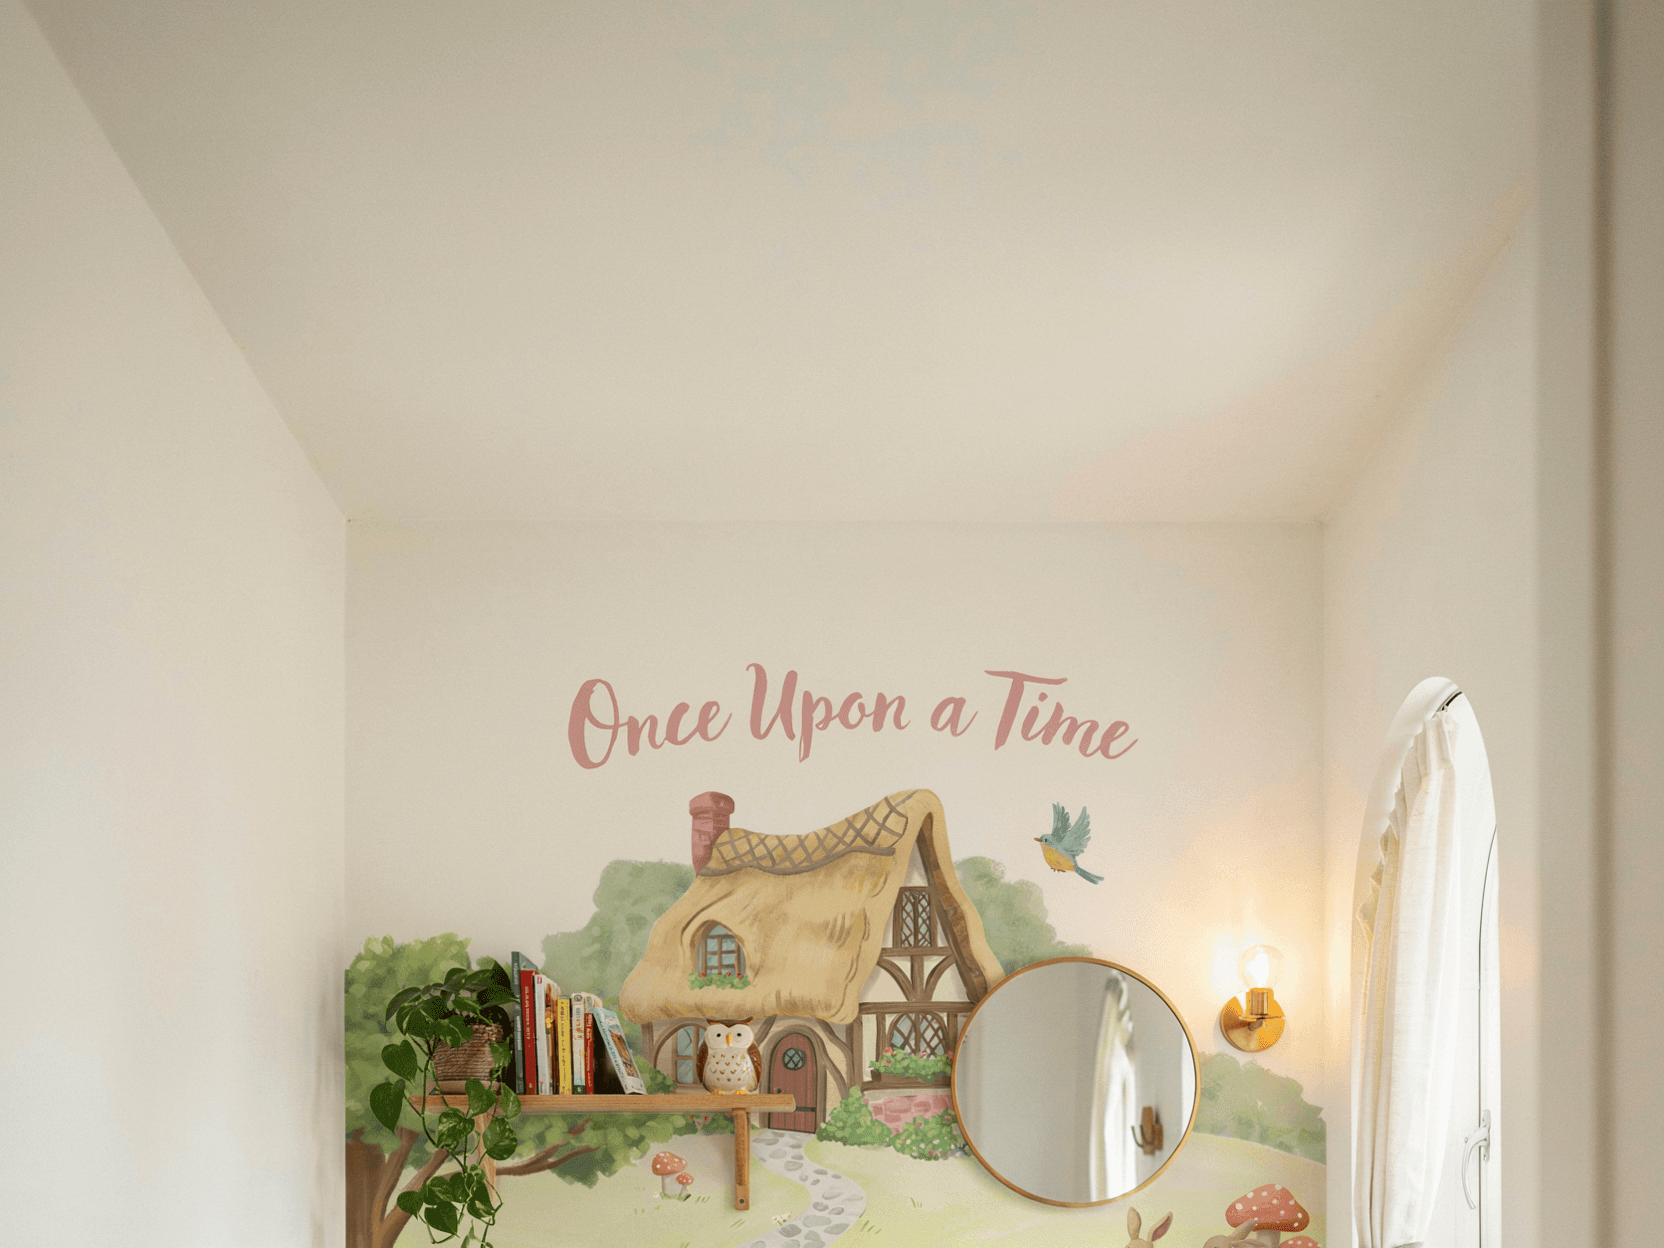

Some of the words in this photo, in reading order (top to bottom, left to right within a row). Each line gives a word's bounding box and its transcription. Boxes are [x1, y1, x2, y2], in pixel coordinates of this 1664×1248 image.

[567, 678, 733, 770] Once
[745, 662, 911, 763] Upon
[930, 696, 979, 738] a
[984, 669, 1139, 760] Time
